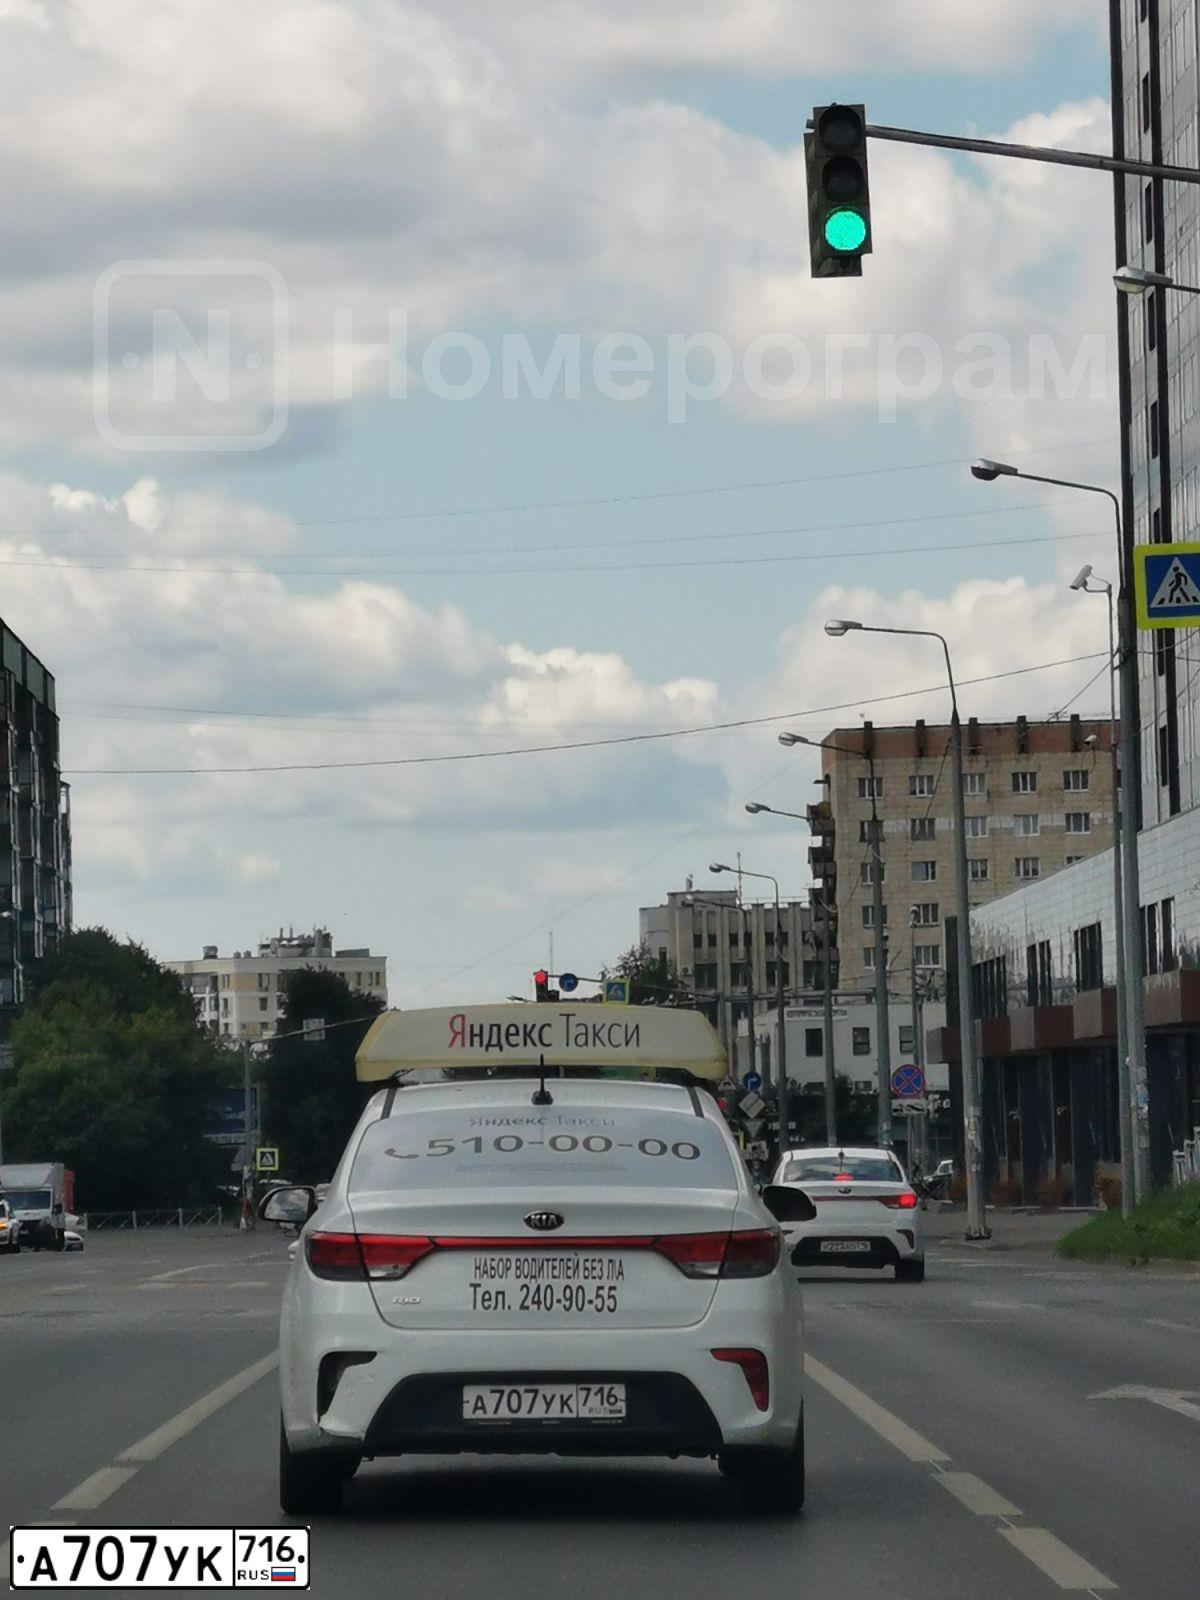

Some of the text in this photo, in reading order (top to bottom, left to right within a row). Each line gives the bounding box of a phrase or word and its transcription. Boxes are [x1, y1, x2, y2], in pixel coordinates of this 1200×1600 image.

[448, 1012, 641, 1052] Яндекс Такси
[469, 1114, 616, 1128] Яндекс Такси
[427, 1134, 701, 1161] 510-00-00
[474, 1257, 512, 1280] НАБОР
[515, 1252, 580, 1284] ВОДИТЕЛЕЙ
[583, 1257, 604, 1281] БЕЗ
[469, 1283, 618, 1313] Тел. 240-90-55
[472, 1386, 619, 1415] А707УК 716
